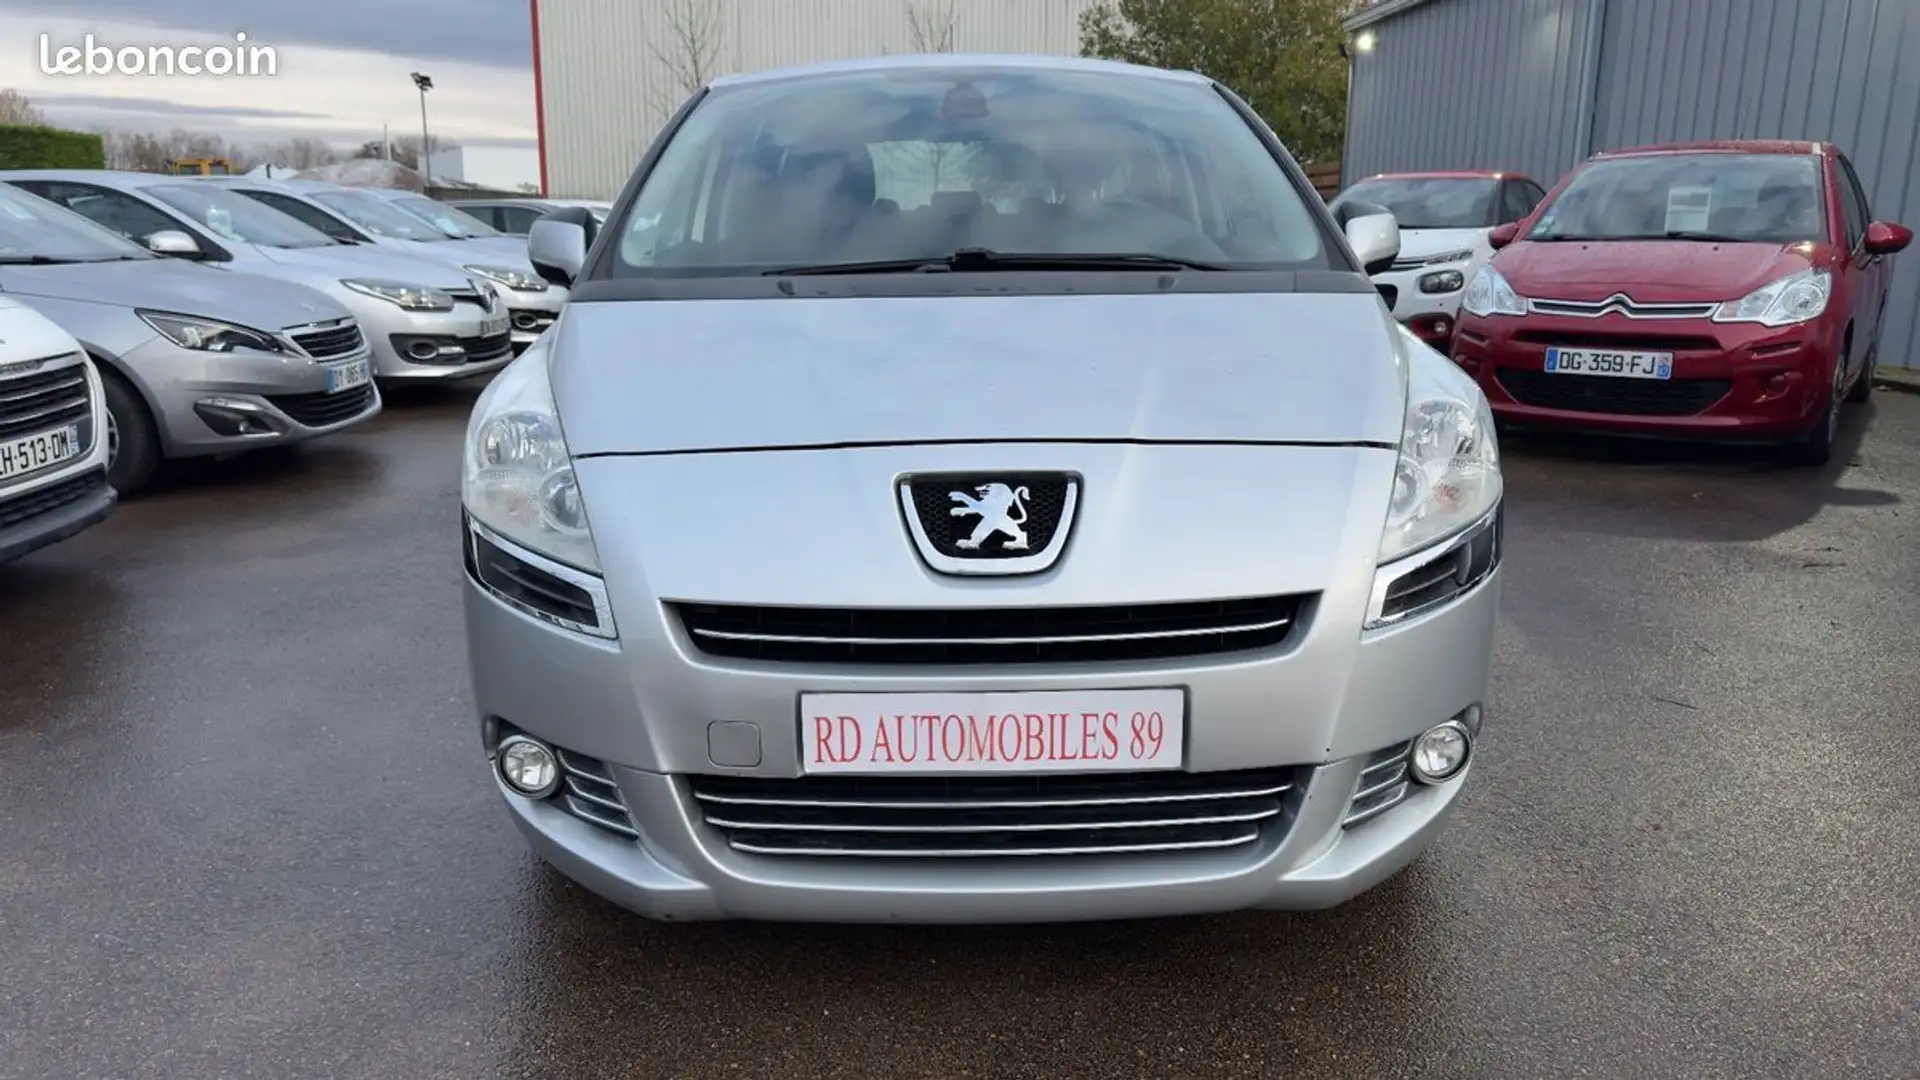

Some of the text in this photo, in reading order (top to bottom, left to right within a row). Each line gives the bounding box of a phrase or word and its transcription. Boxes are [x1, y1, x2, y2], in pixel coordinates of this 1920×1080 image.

[1559, 351, 1656, 374] DG-359-FJ
[0, 431, 70, 474] H-513-DM
[813, 711, 1164, 763] RD AUTOMOBILES 89
